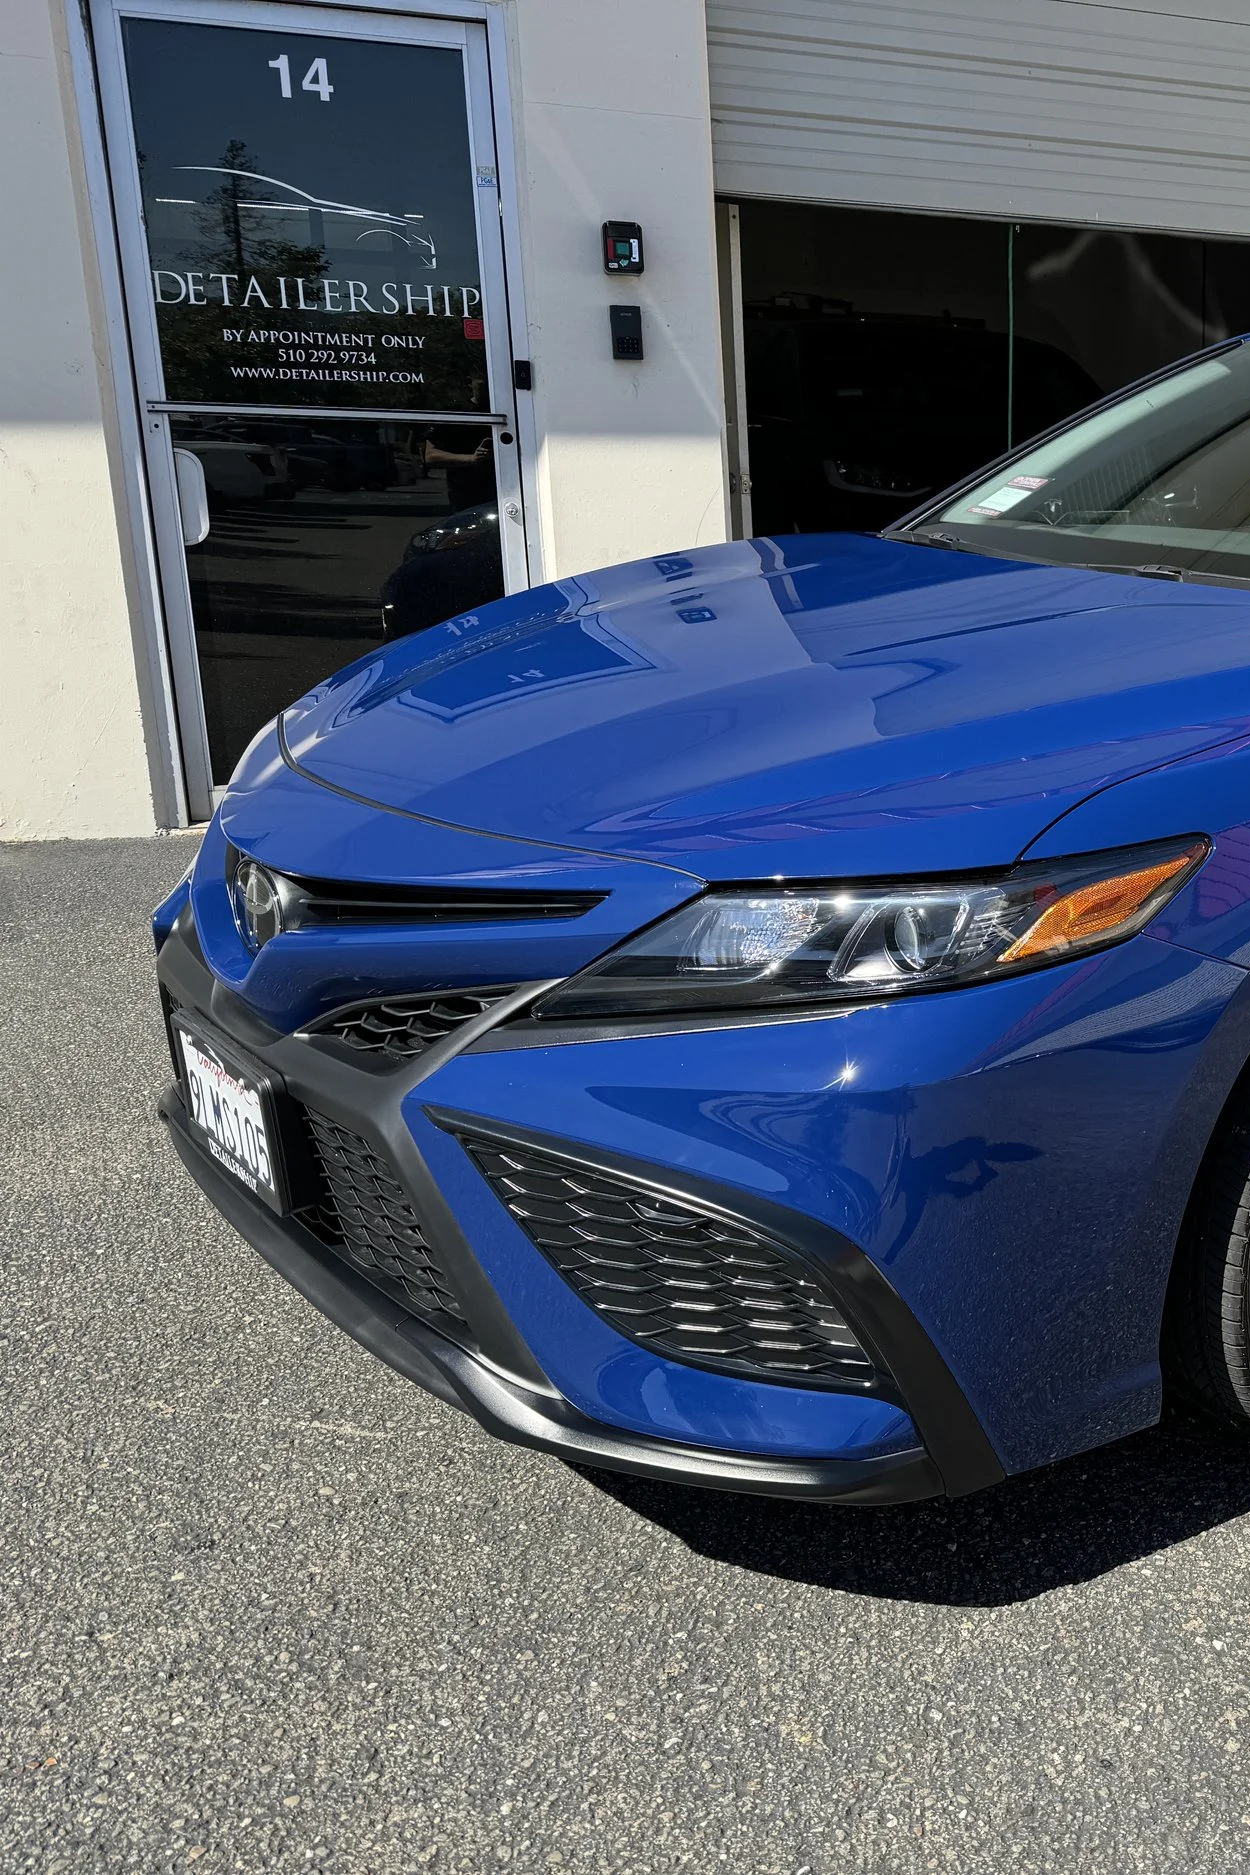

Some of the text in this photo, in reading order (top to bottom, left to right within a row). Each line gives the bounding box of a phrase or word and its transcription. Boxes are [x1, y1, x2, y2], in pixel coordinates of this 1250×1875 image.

[268, 54, 334, 101] 14
[152, 270, 480, 318] DETAILERSHIP
[223, 329, 425, 348] BY APPOINTMENT ONLY
[278, 349, 377, 365] 510 292 9734
[230, 366, 425, 383] WWW.DETAILERSHIP.COM
[189, 1068, 271, 1186] 9LMS105
